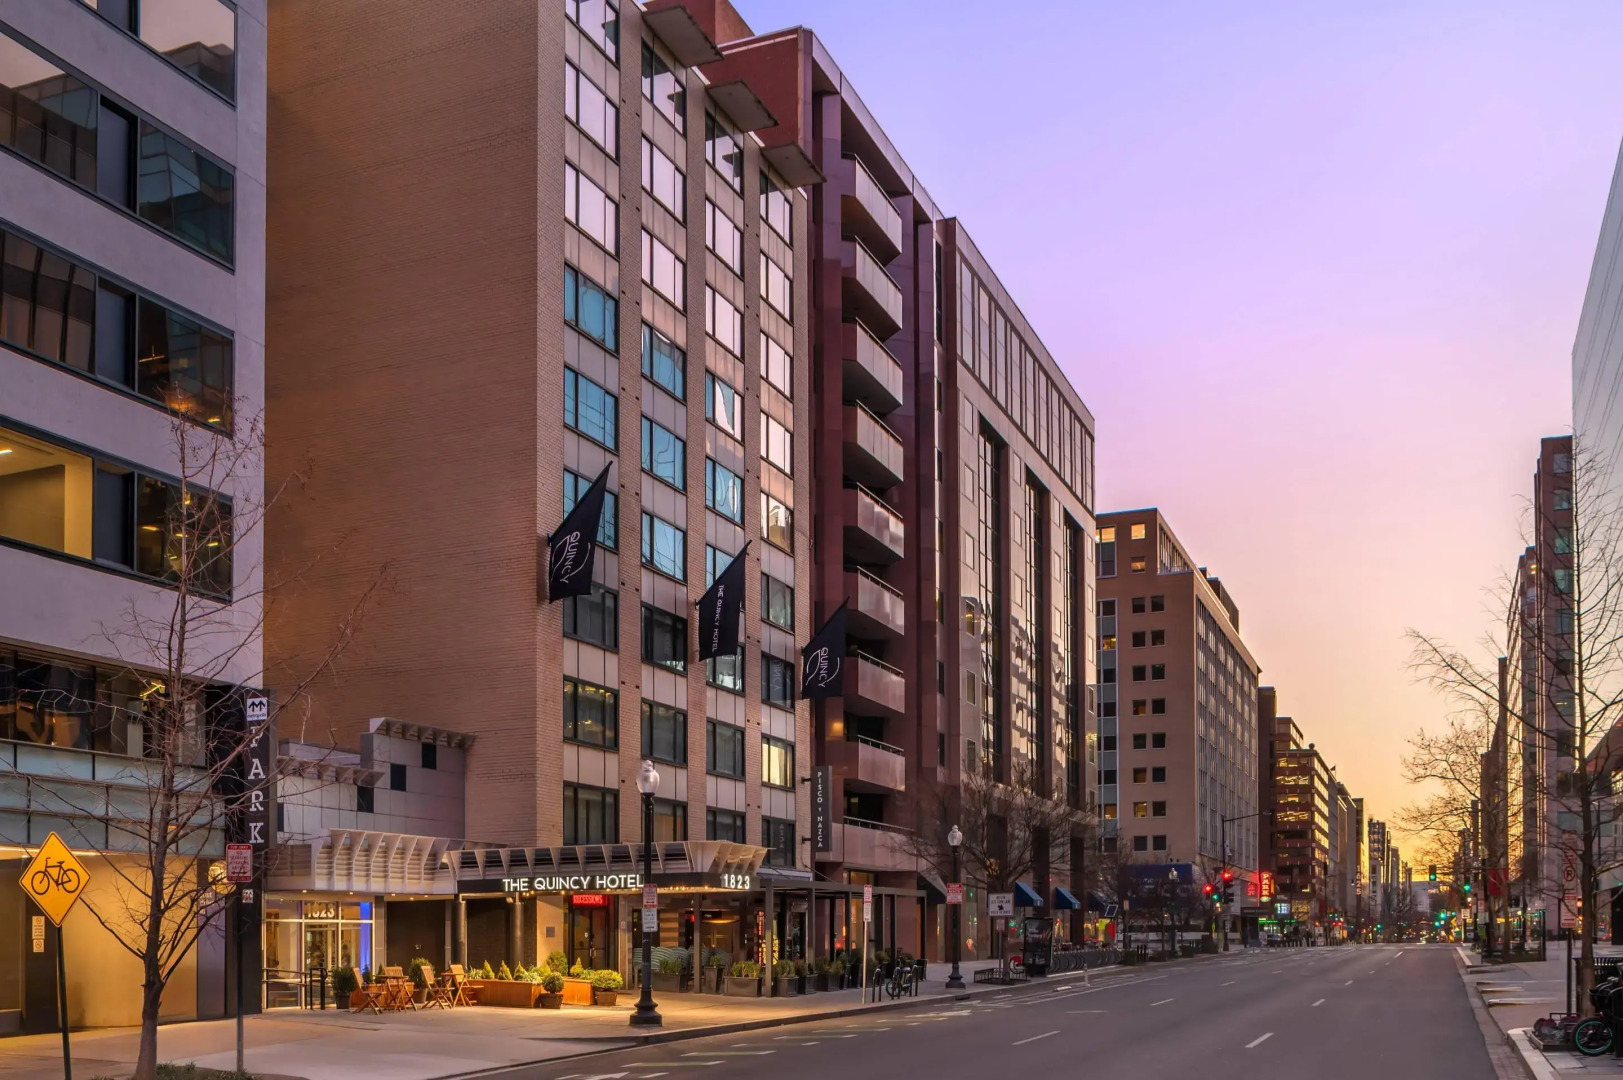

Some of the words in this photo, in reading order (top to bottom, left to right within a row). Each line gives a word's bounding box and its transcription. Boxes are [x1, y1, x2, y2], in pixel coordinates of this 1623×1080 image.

[560, 531, 580, 583] QUINCY
[818, 647, 829, 688] QUINCY
[248, 726, 265, 844] PARK
[502, 878, 529, 892] THE
[534, 876, 591, 891] QUINCY
[596, 874, 644, 889] HOTEL
[723, 873, 750, 890] 1823
[1261, 873, 1270, 896] PARK
